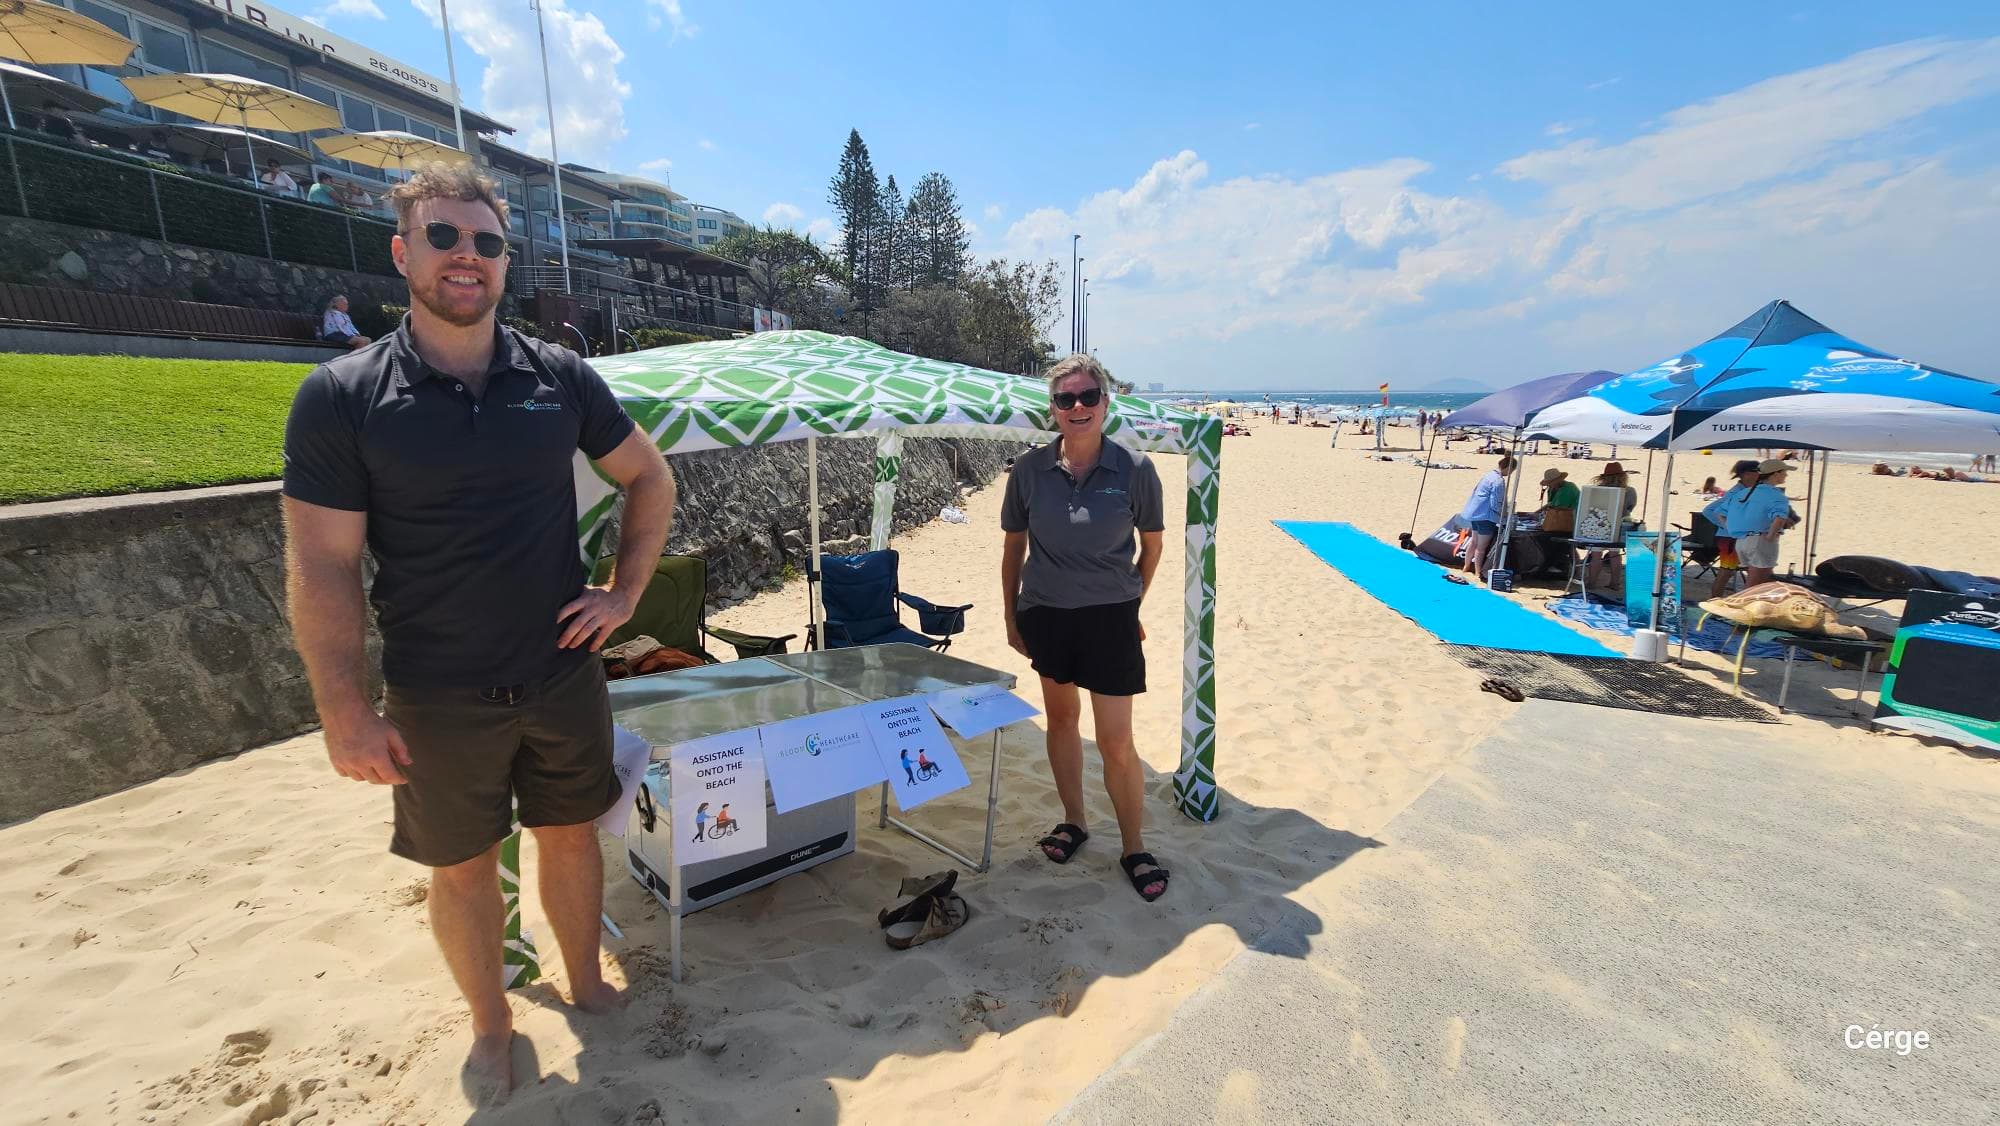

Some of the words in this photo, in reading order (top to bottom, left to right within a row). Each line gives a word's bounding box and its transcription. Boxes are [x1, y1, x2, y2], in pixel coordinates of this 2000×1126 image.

[1711, 423, 1793, 432] TURTLECARE
[1950, 611, 1996, 622] TurtleCare
[880, 706, 919, 720] ASSISTANCE
[887, 718, 908, 729] ONTO
[908, 715, 922, 723] THE
[898, 727, 922, 738] BEACH
[820, 732, 860, 747] HEALTHCARE
[692, 747, 745, 765] ASSISTANCE
[696, 765, 724, 778] ONTO
[726, 761, 743, 772] THE
[706, 777, 736, 790] BEACH
[790, 848, 813, 861] DUNE
